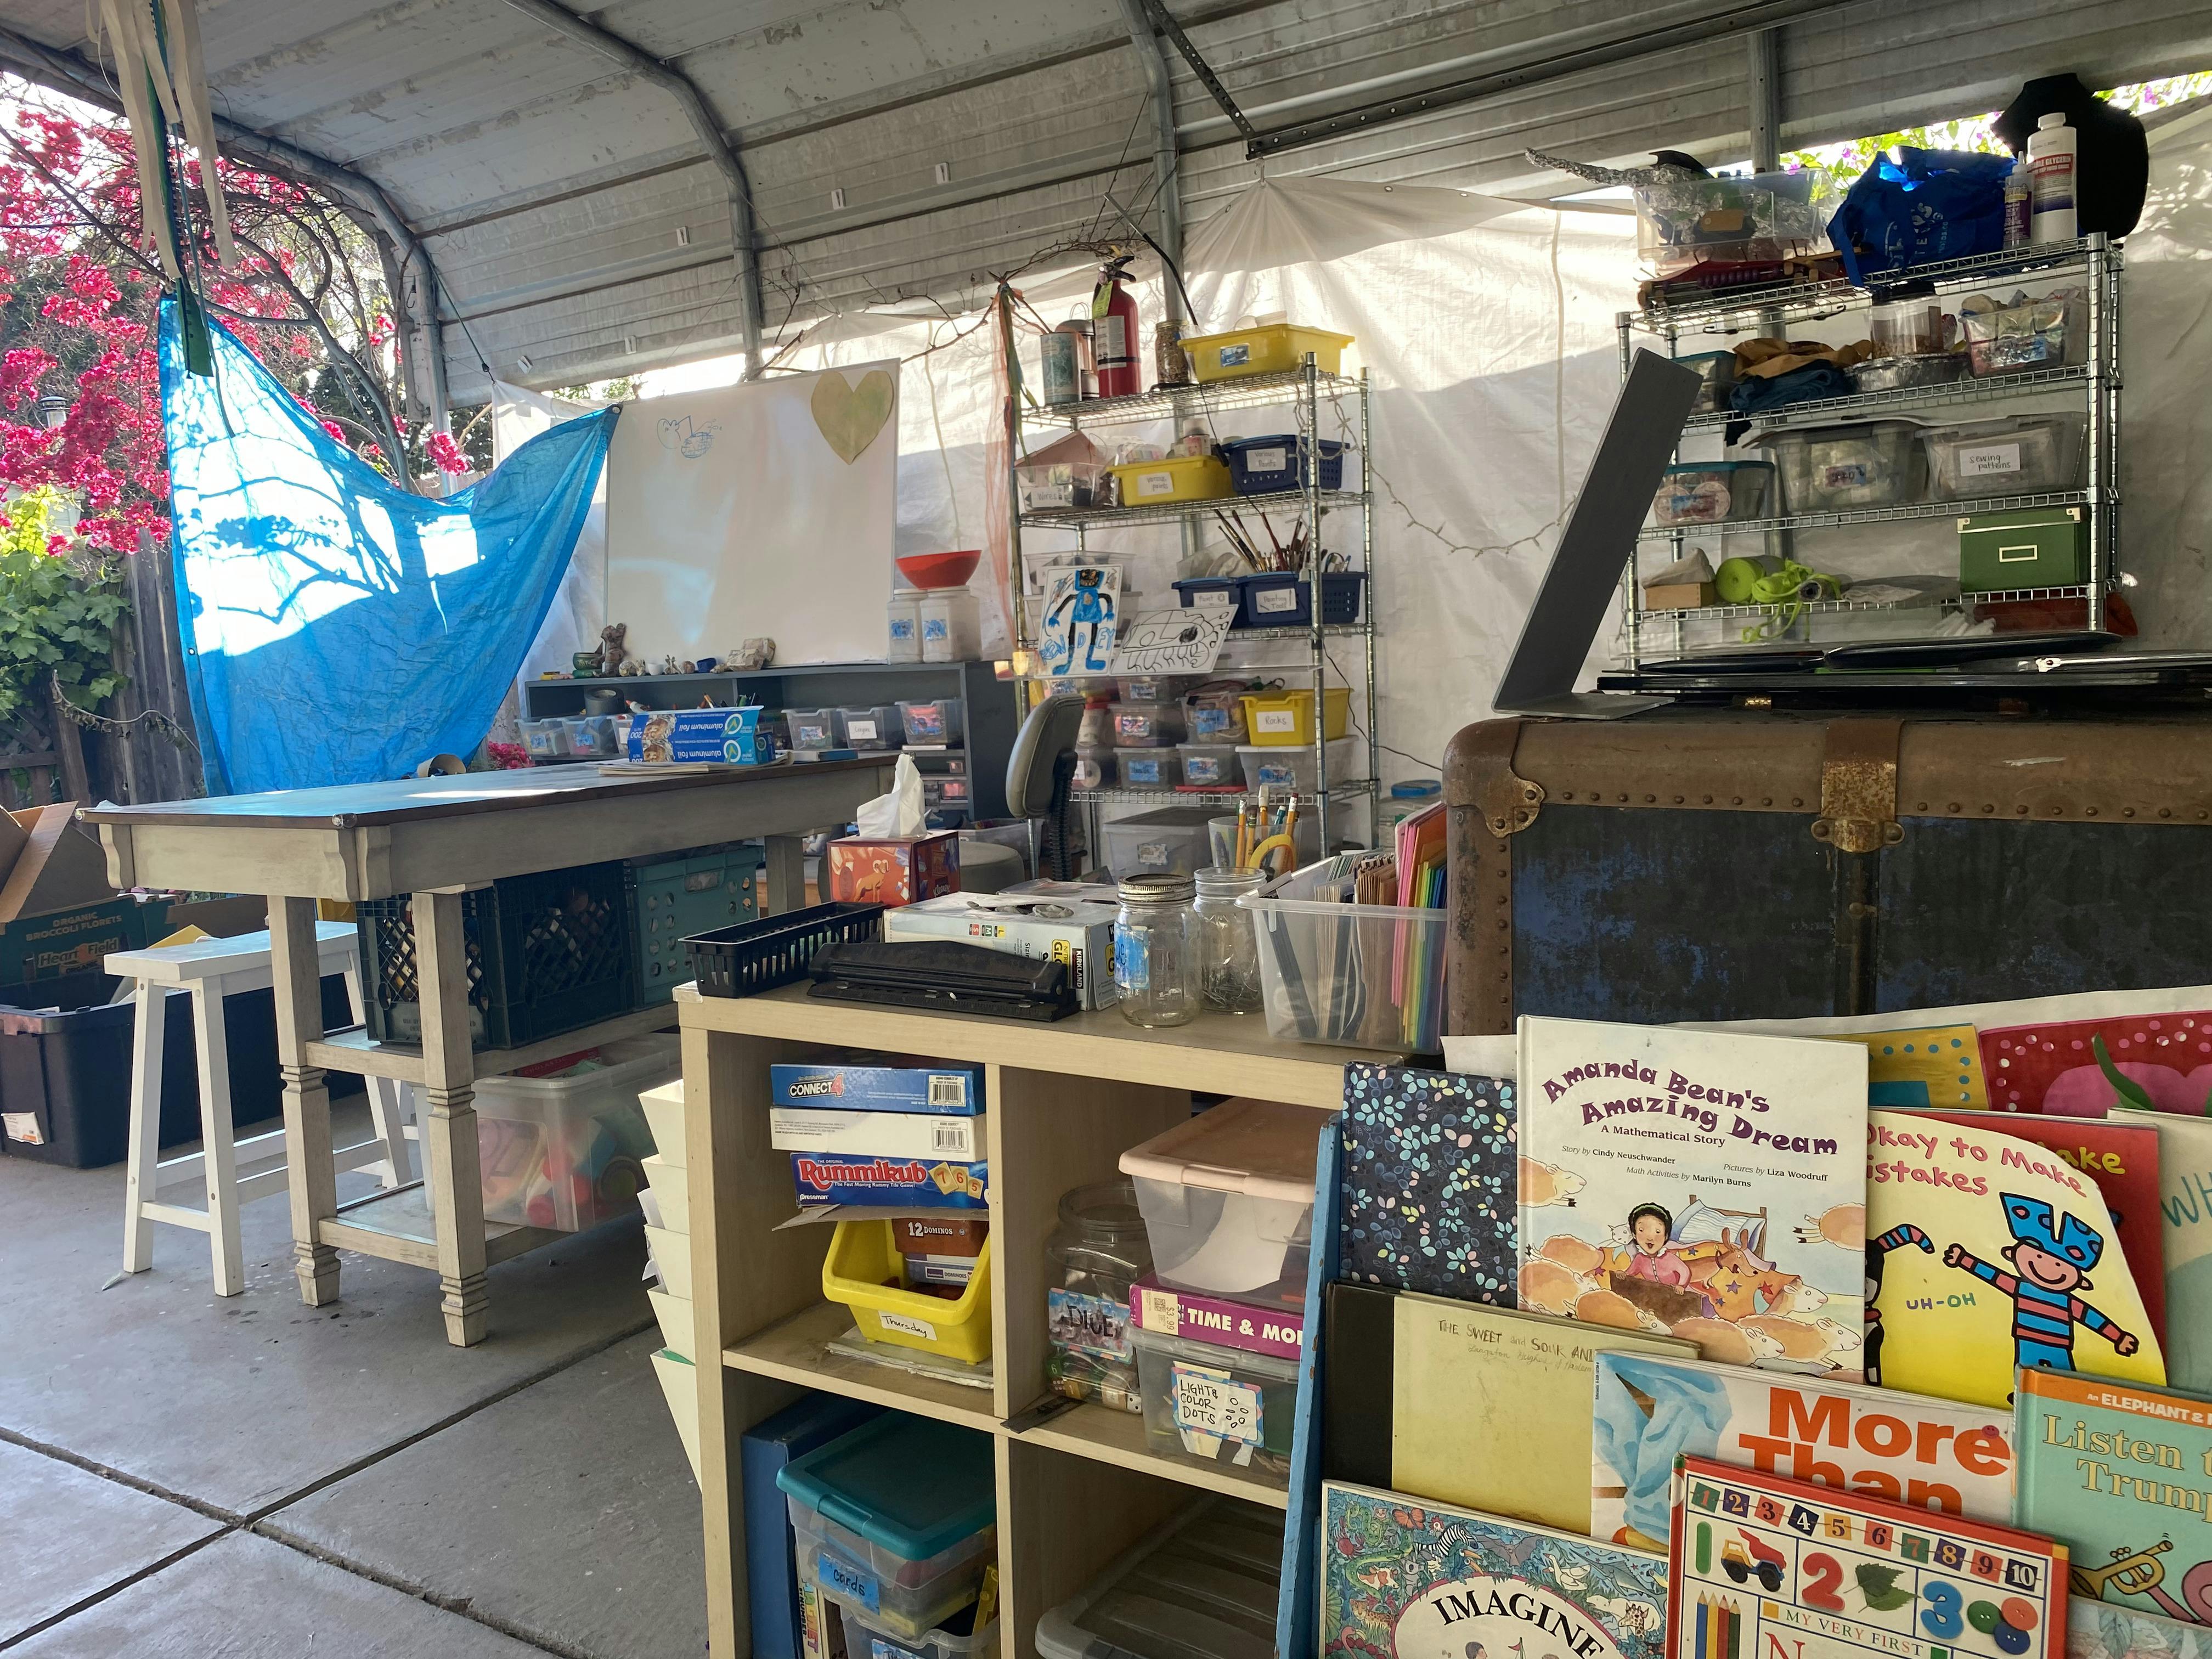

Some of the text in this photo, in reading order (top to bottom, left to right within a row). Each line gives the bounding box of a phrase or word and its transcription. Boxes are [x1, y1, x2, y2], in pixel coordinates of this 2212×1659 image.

[1265, 716, 1286, 725] Rocks
[26, 915, 122, 941] BROCCOLI FLORETS
[53, 912, 98, 927] ORGANIC
[88, 939, 118, 955] Field
[789, 1082, 832, 1097] CONNECT
[831, 1073, 844, 1097] 4
[1541, 1059, 1770, 1113] Amanda Bean's
[1581, 1094, 1838, 1155] Amazing Dream
[1601, 1125, 1725, 1148] A Mathematical Story
[1561, 1145, 1581, 1155] Story
[1592, 1149, 1615, 1158] Cindy
[1617, 1151, 1676, 1165] Neuschwander
[1950, 1137, 1989, 1162] to
[2001, 1147, 2087, 1198] Make
[2036, 1141, 2125, 1175] ake
[798, 1160, 927, 1190] Rummikub
[937, 1170, 978, 1191] 7 6 5
[1626, 1166, 1752, 1187] Math Activities by Marilyn Burns
[1723, 1163, 1829, 1182] Pictures by Liza Woodruff
[908, 1222, 953, 1237] 12 DOMINOS
[1906, 1293, 1977, 1311] UH-OH
[881, 1316, 927, 1338] Thursday
[1067, 1305, 1114, 1337] DICE
[1166, 1306, 1175, 1330] $3.99
[1187, 1307, 1232, 1331] TIME
[1239, 1319, 1255, 1336] &
[1438, 1319, 1459, 1335] THE
[1466, 1324, 1502, 1344] SWEET
[1510, 1336, 1526, 1345] and
[1180, 1393, 1216, 1410] COLOR
[2101, 1393, 2191, 1421] ELEPHANT
[2191, 1412, 2204, 1424] &
[1182, 1406, 1216, 1425] DOTS
[1769, 1387, 2010, 1476] More
[2042, 1414, 2185, 1471] Listen
[1701, 1489, 2036, 1585] 1 2 3 4 5 6 7 8 9 10
[833, 1568, 865, 1596] Cards
[1801, 1552, 1845, 1611] 2
[1920, 1581, 1964, 1640] 3
[1431, 1589, 1605, 1659] IMAGINE
[1786, 1609, 1923, 1656] MY VERY FIRST
